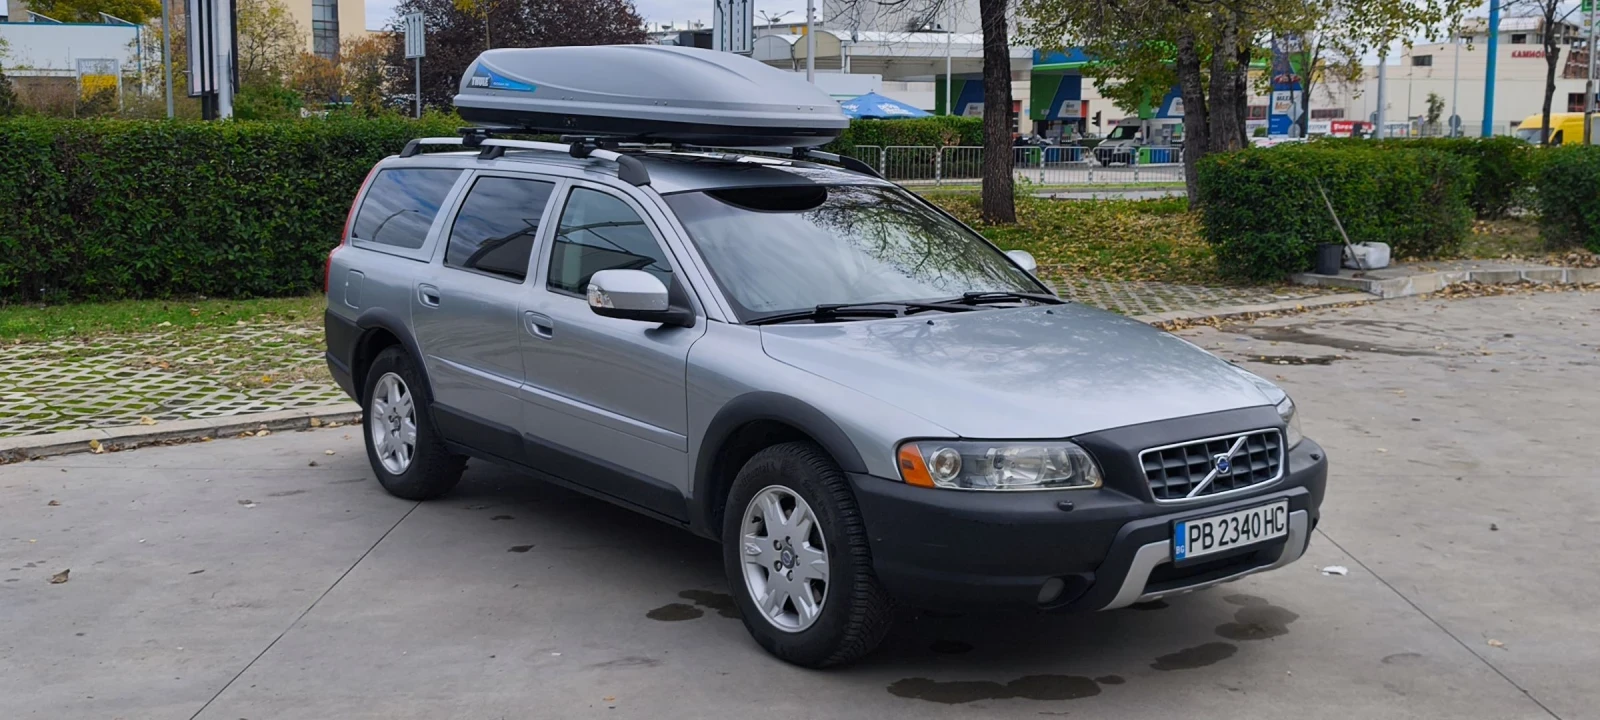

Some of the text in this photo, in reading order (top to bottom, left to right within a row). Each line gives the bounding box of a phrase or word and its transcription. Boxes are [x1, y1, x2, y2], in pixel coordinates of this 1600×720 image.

[471, 77, 489, 86] THULE
[1189, 507, 1285, 552] PB 2340 HC
[1176, 546, 1185, 554] BG
